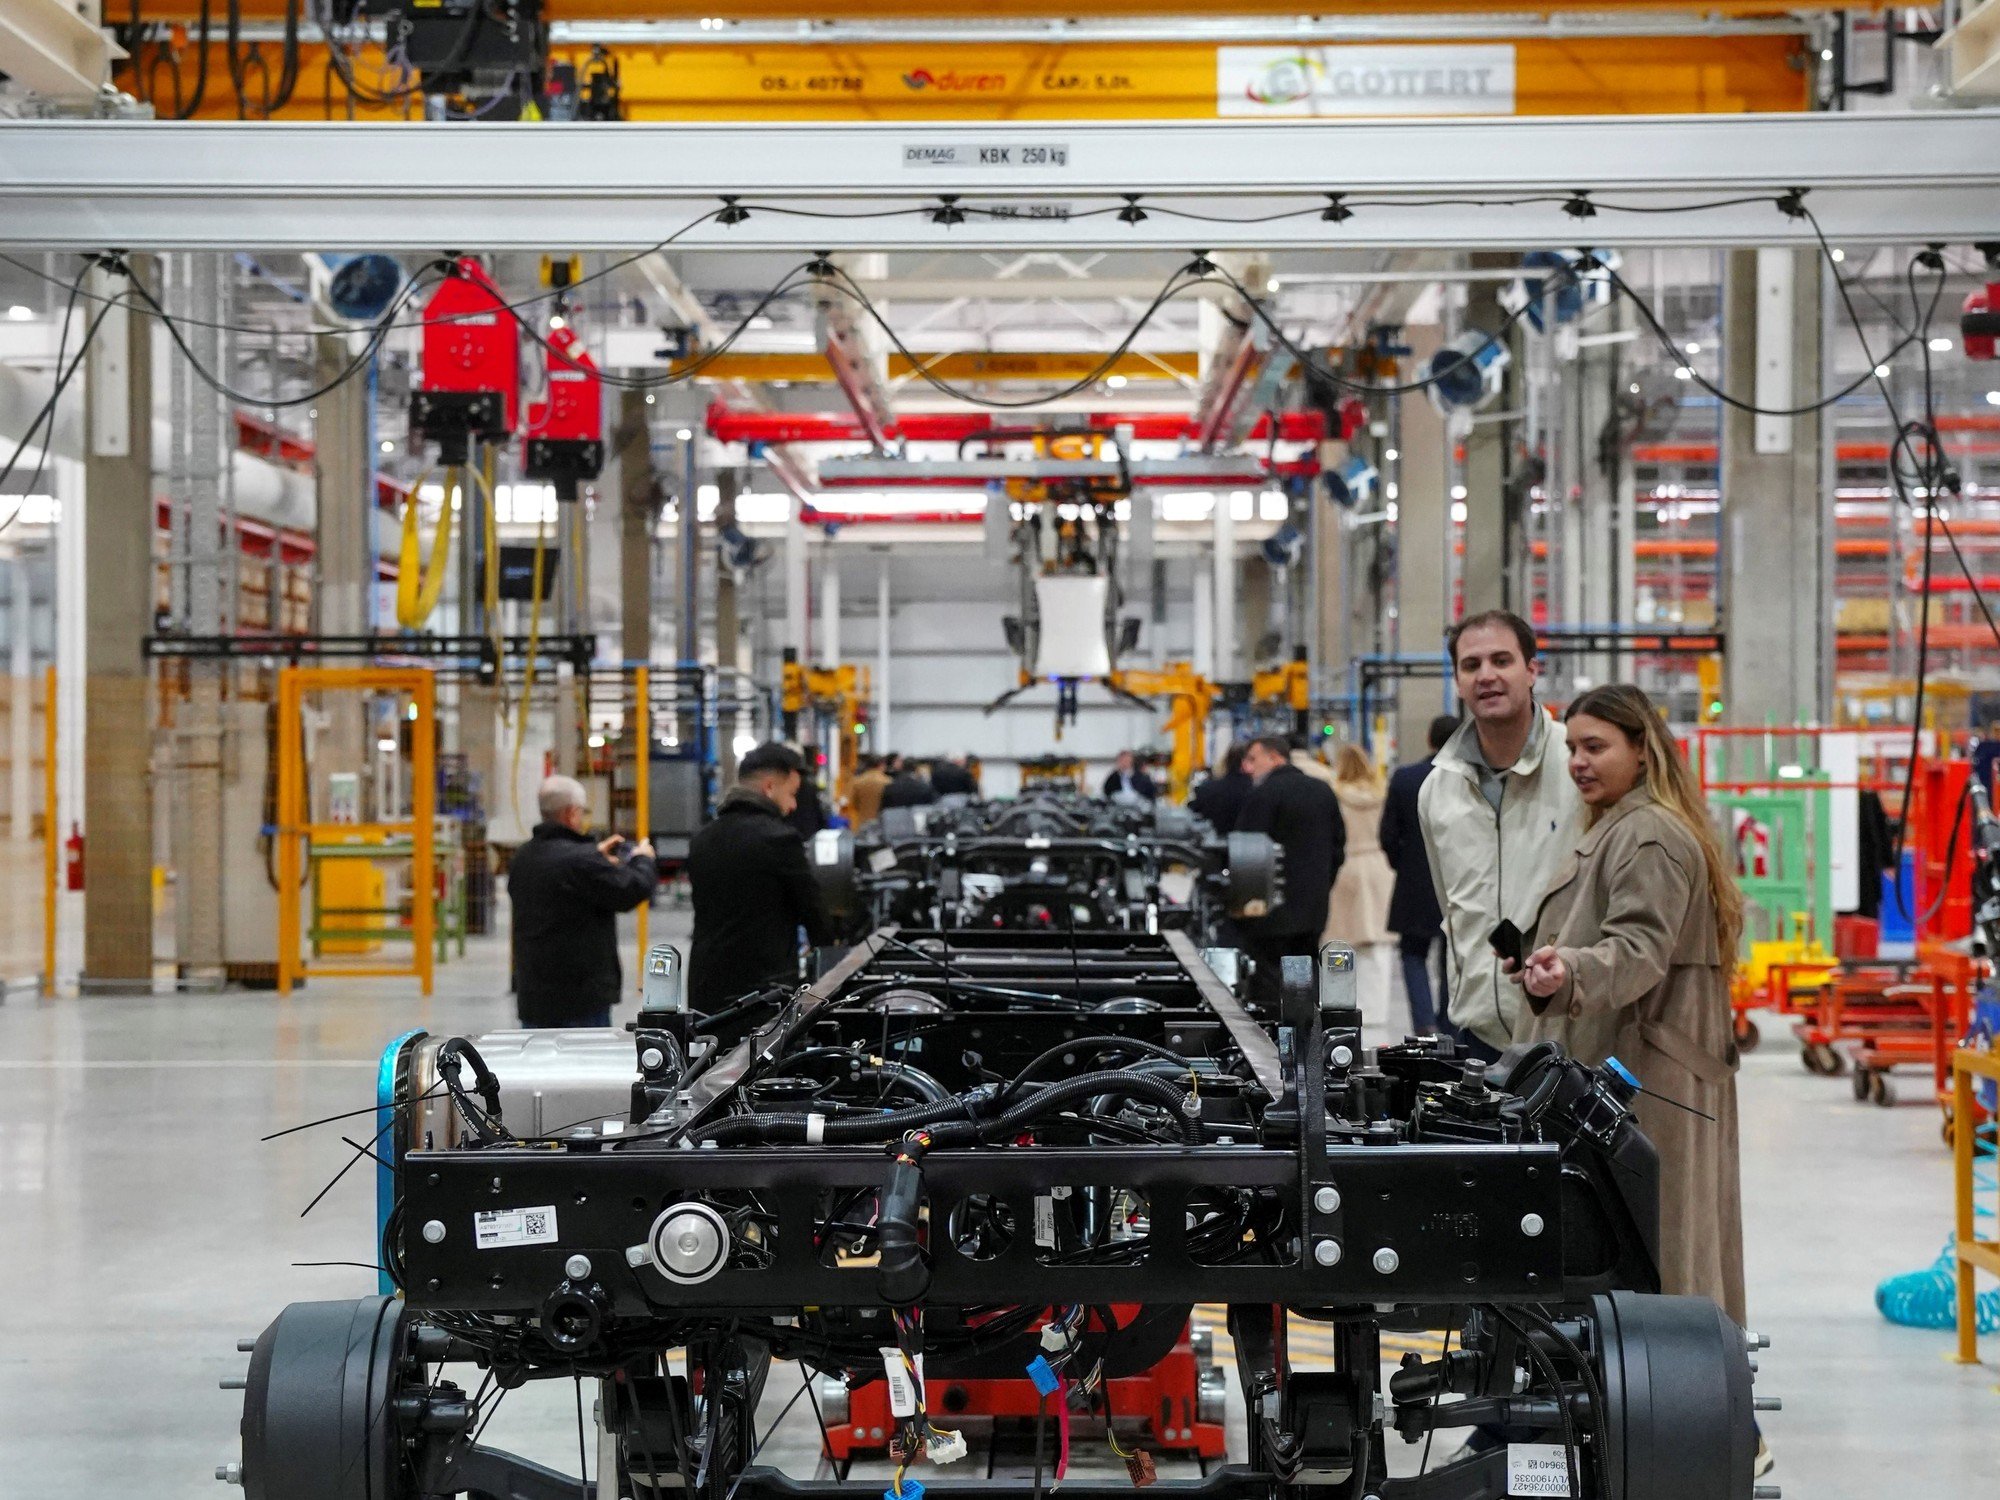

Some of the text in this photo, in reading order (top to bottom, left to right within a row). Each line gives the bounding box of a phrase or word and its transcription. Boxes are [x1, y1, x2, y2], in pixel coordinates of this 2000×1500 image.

[906, 148, 1066, 167] DEMAG KBK 250 kg
